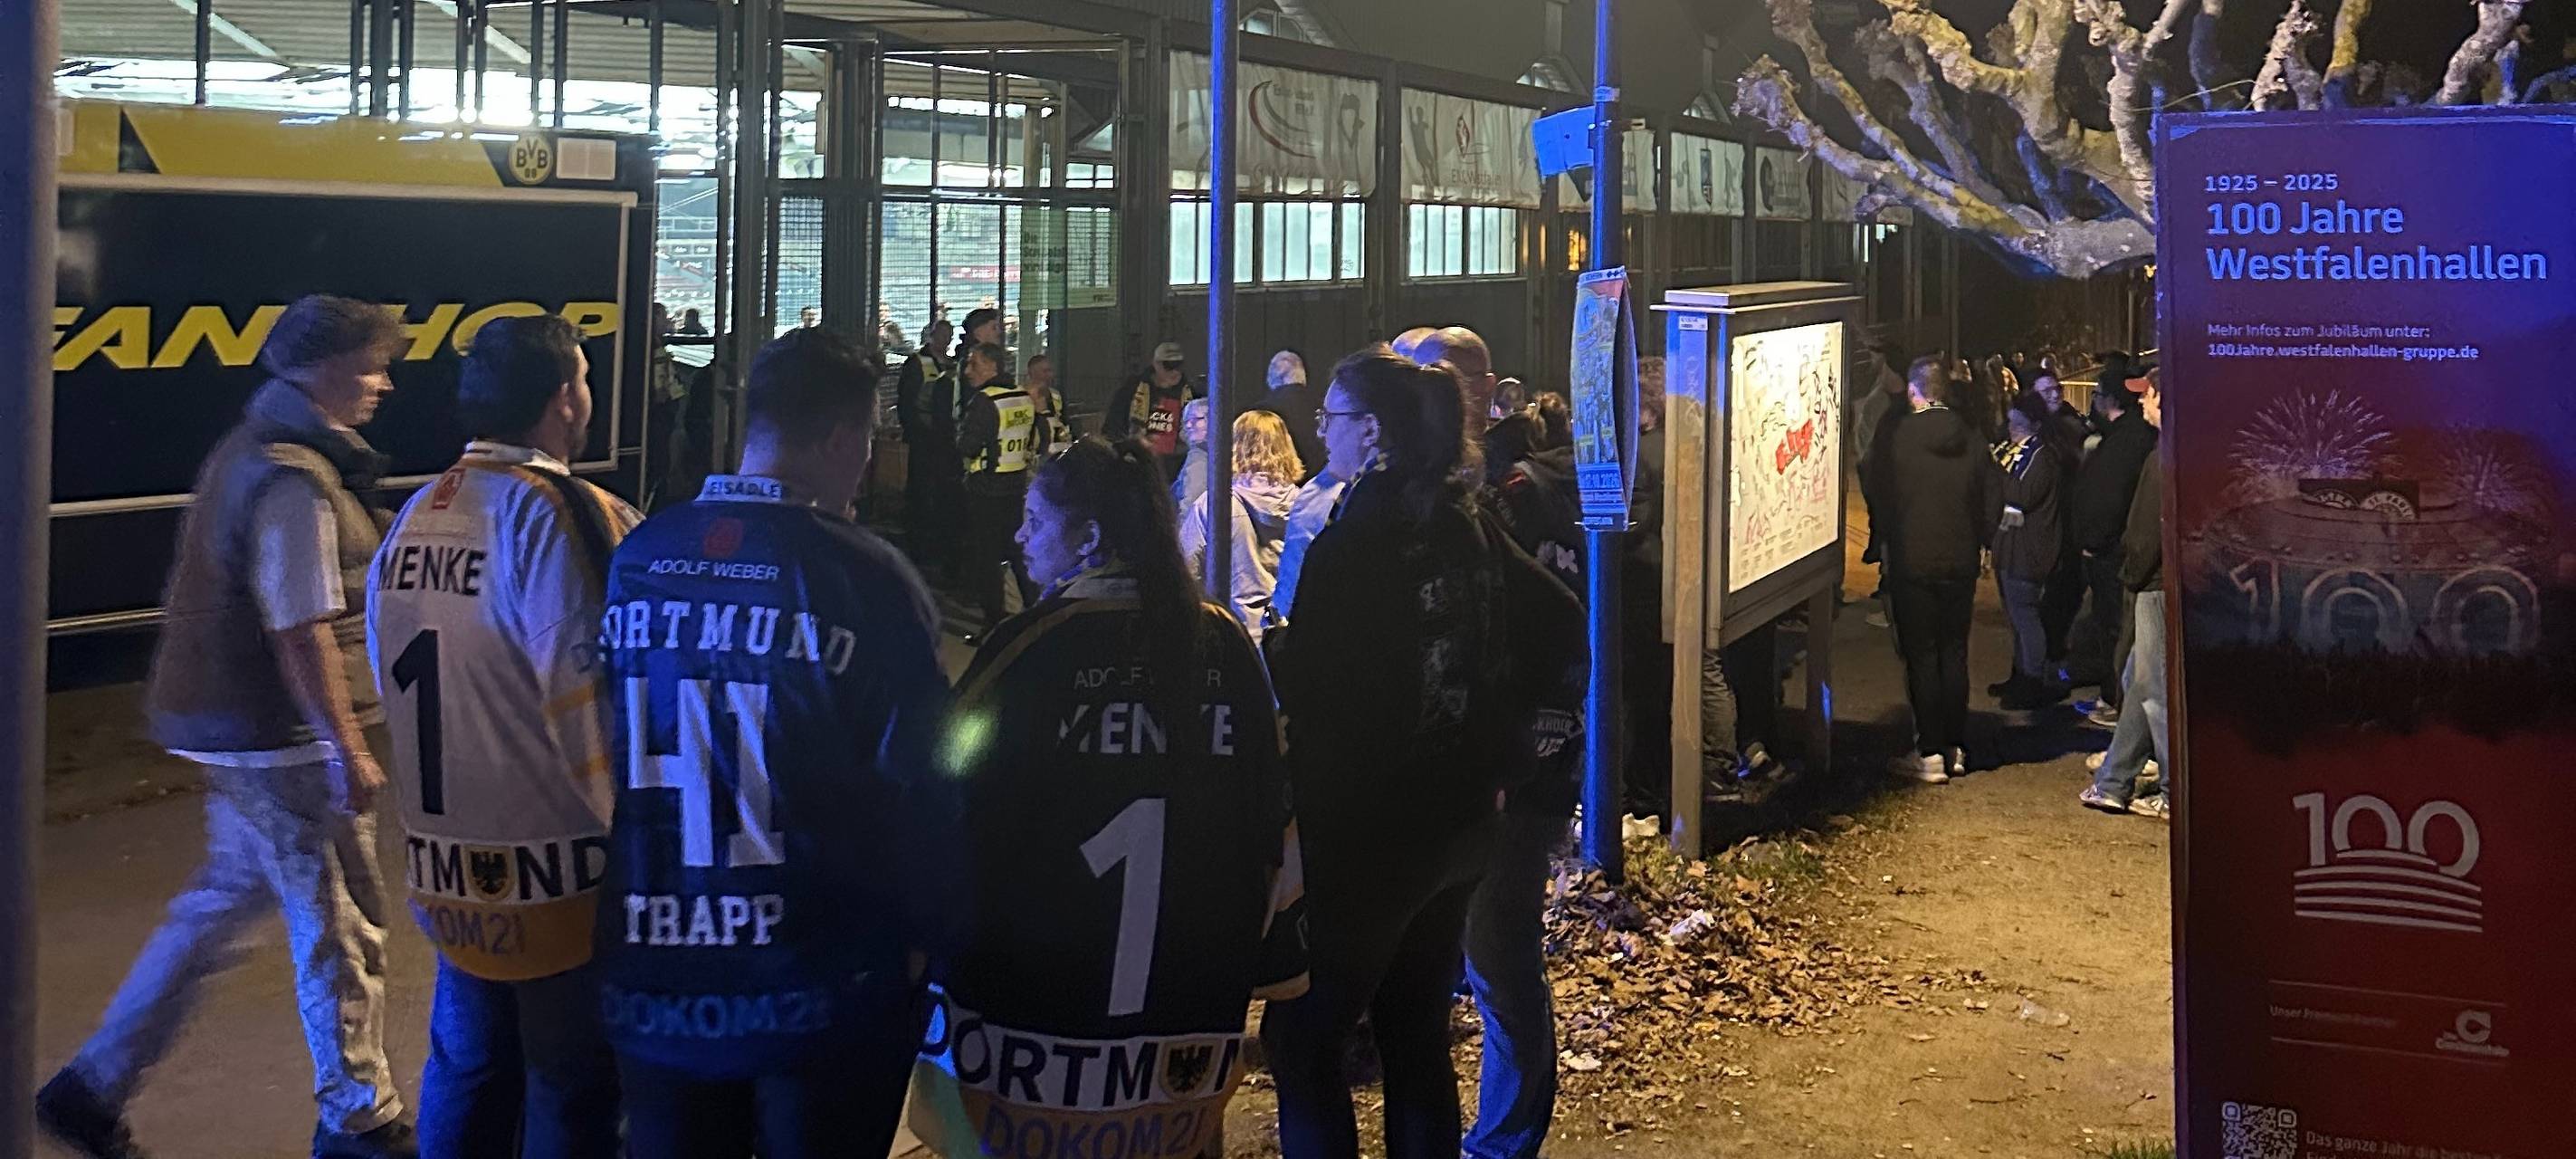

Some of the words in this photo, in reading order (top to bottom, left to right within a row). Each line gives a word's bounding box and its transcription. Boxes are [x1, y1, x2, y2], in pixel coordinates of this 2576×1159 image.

[516, 139, 549, 169] BVB
[2205, 175, 2257, 191] 1925
[2284, 174, 2338, 191] 2025
[2208, 203, 2281, 235] 100
[2290, 199, 2404, 234] Jahre
[2206, 246, 2548, 280] Westfalenhallen
[2209, 324, 2243, 336] Mehr
[2247, 323, 2280, 337] Infos
[2284, 327, 2314, 337] zum
[2317, 325, 2381, 338] Jubiläum
[2384, 326, 2430, 338] unter:
[377, 545, 487, 596] MENKE
[647, 560, 711, 575] ADOLF
[713, 562, 781, 581] WEBER
[392, 628, 444, 815] 1
[625, 676, 786, 867] 41
[2291, 791, 2482, 880] 100
[624, 893, 785, 946] TRAPP
[1079, 797, 1166, 1017] 1
[2306, 1130, 2333, 1147] Das
[2335, 1136, 2378, 1153] ganze
[2380, 1140, 2412, 1155] Jahr
